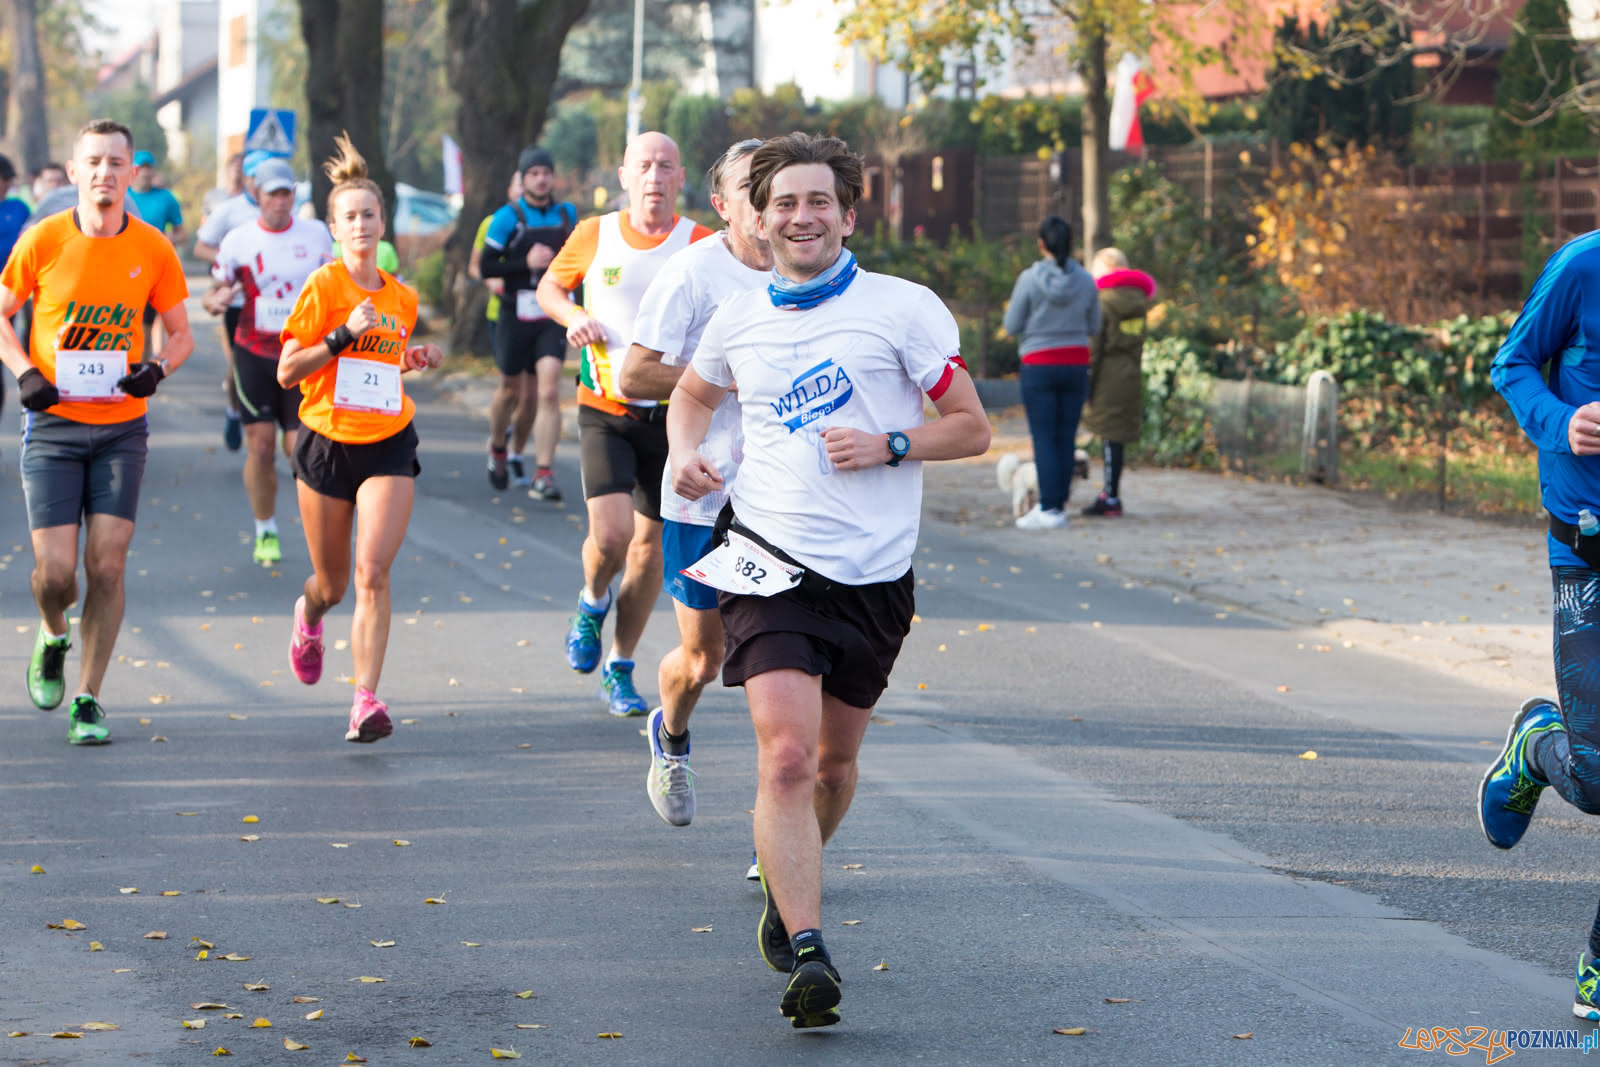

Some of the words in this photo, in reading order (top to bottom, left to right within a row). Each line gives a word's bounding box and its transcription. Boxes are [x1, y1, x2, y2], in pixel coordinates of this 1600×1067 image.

[78, 363, 104, 375] 243
[363, 373, 378, 386] 21
[770, 367, 851, 418] WILDA
[735, 556, 767, 584] 882
